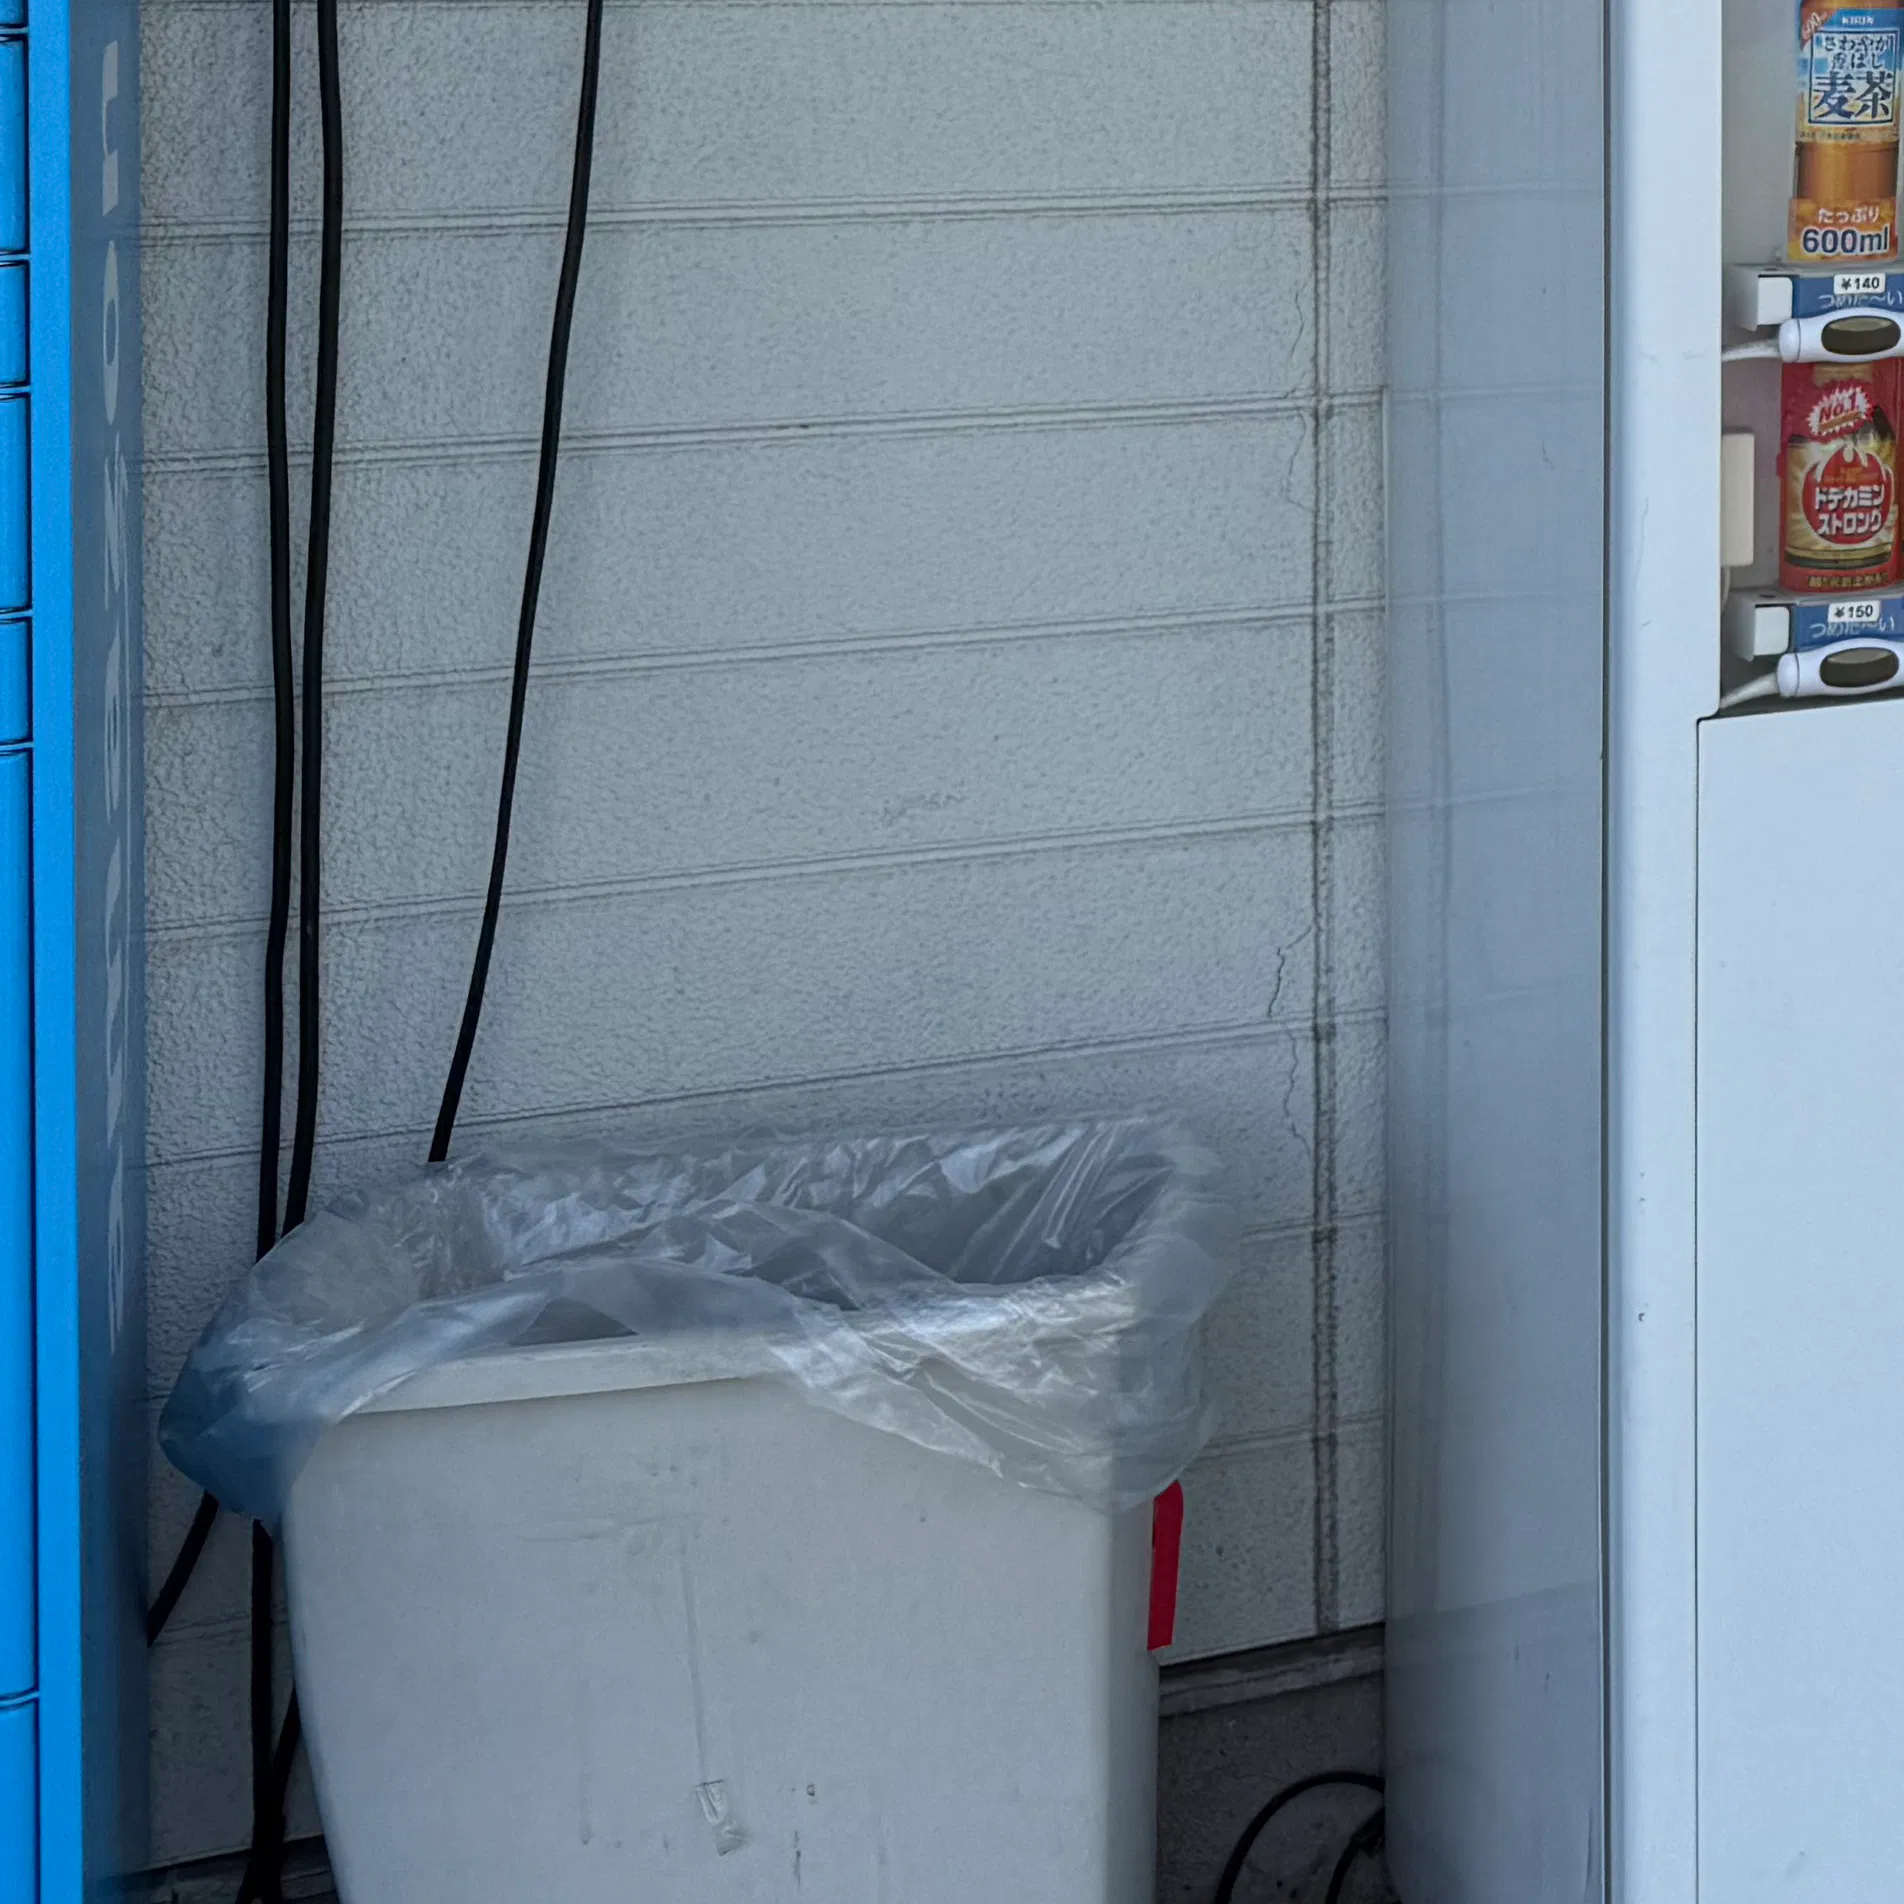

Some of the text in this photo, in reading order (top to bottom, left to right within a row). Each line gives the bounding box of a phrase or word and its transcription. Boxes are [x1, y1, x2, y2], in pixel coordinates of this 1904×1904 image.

[1841, 15, 1875, 26] KIRIN
[1813, 70, 1895, 120] 麦茶
[1817, 206, 1880, 225] たっぷり
[1802, 225, 1890, 254] 600ml
[1840, 276, 1880, 290] ¥140
[1815, 484, 1886, 511] ドデカミン
